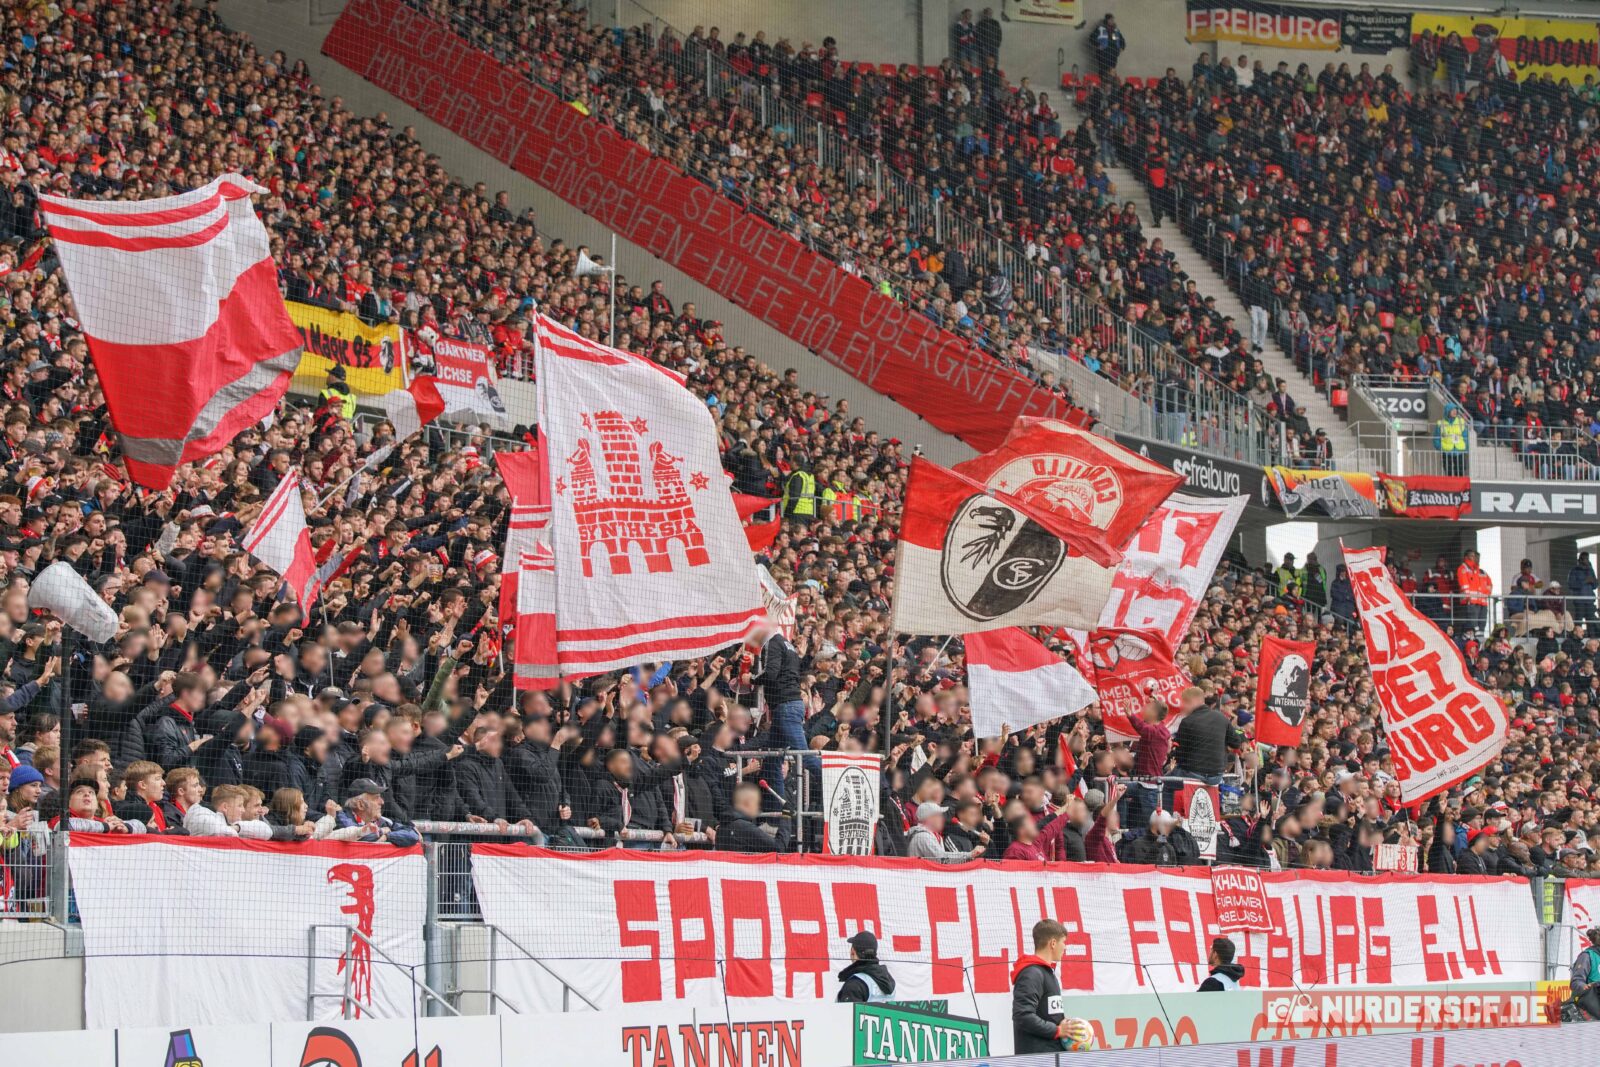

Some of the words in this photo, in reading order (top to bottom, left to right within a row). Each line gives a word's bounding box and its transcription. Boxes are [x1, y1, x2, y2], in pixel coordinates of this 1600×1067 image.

[1190, 8, 1340, 45] FREIBURG
[487, 70, 614, 167] SCHLUSS
[617, 143, 682, 196] MIT
[682, 184, 848, 309] SEXUELLEN
[789, 305, 890, 384] HOLEN
[1480, 491, 1598, 515] RAFI
[578, 518, 702, 542] SYNTHESIA
[1214, 873, 1258, 892] KHALID
[622, 1019, 805, 1067] TANNEN
[859, 1013, 984, 1063] TANNEN
